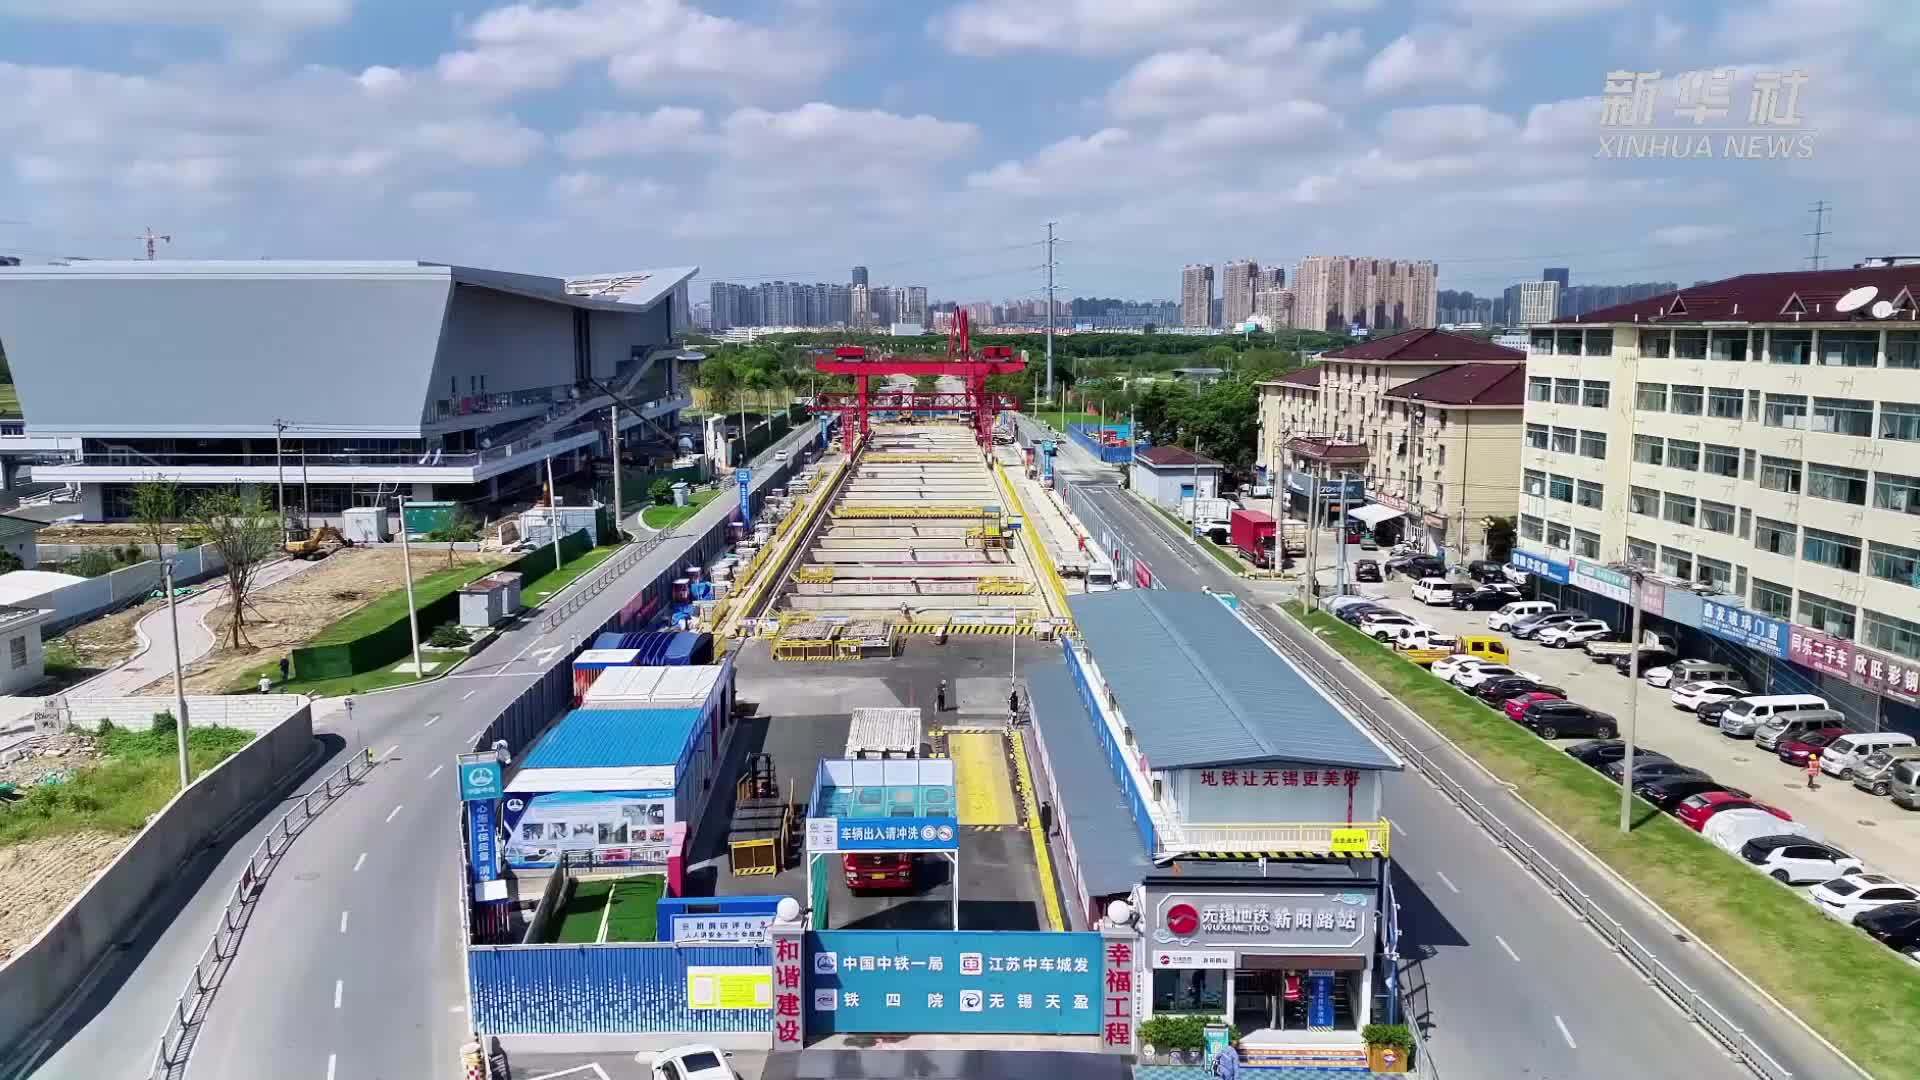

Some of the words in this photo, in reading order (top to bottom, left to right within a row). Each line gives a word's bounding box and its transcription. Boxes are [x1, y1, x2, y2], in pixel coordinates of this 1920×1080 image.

[1200, 770, 1360, 787] 地铁让无锡更美好
[841, 825, 918, 841] 车辆出入请冲洗
[1202, 908, 1269, 924] 无锡地铁
[1274, 909, 1356, 930] 新阳路站
[843, 956, 943, 972] 中国中铁一局
[989, 956, 1089, 972] 江苏中车城发
[776, 938, 800, 1043] 和谐建设
[1105, 944, 1131, 1046] 幸福工程
[844, 992, 944, 1008] 铁四院
[989, 993, 1089, 1009] 无锡天盈
